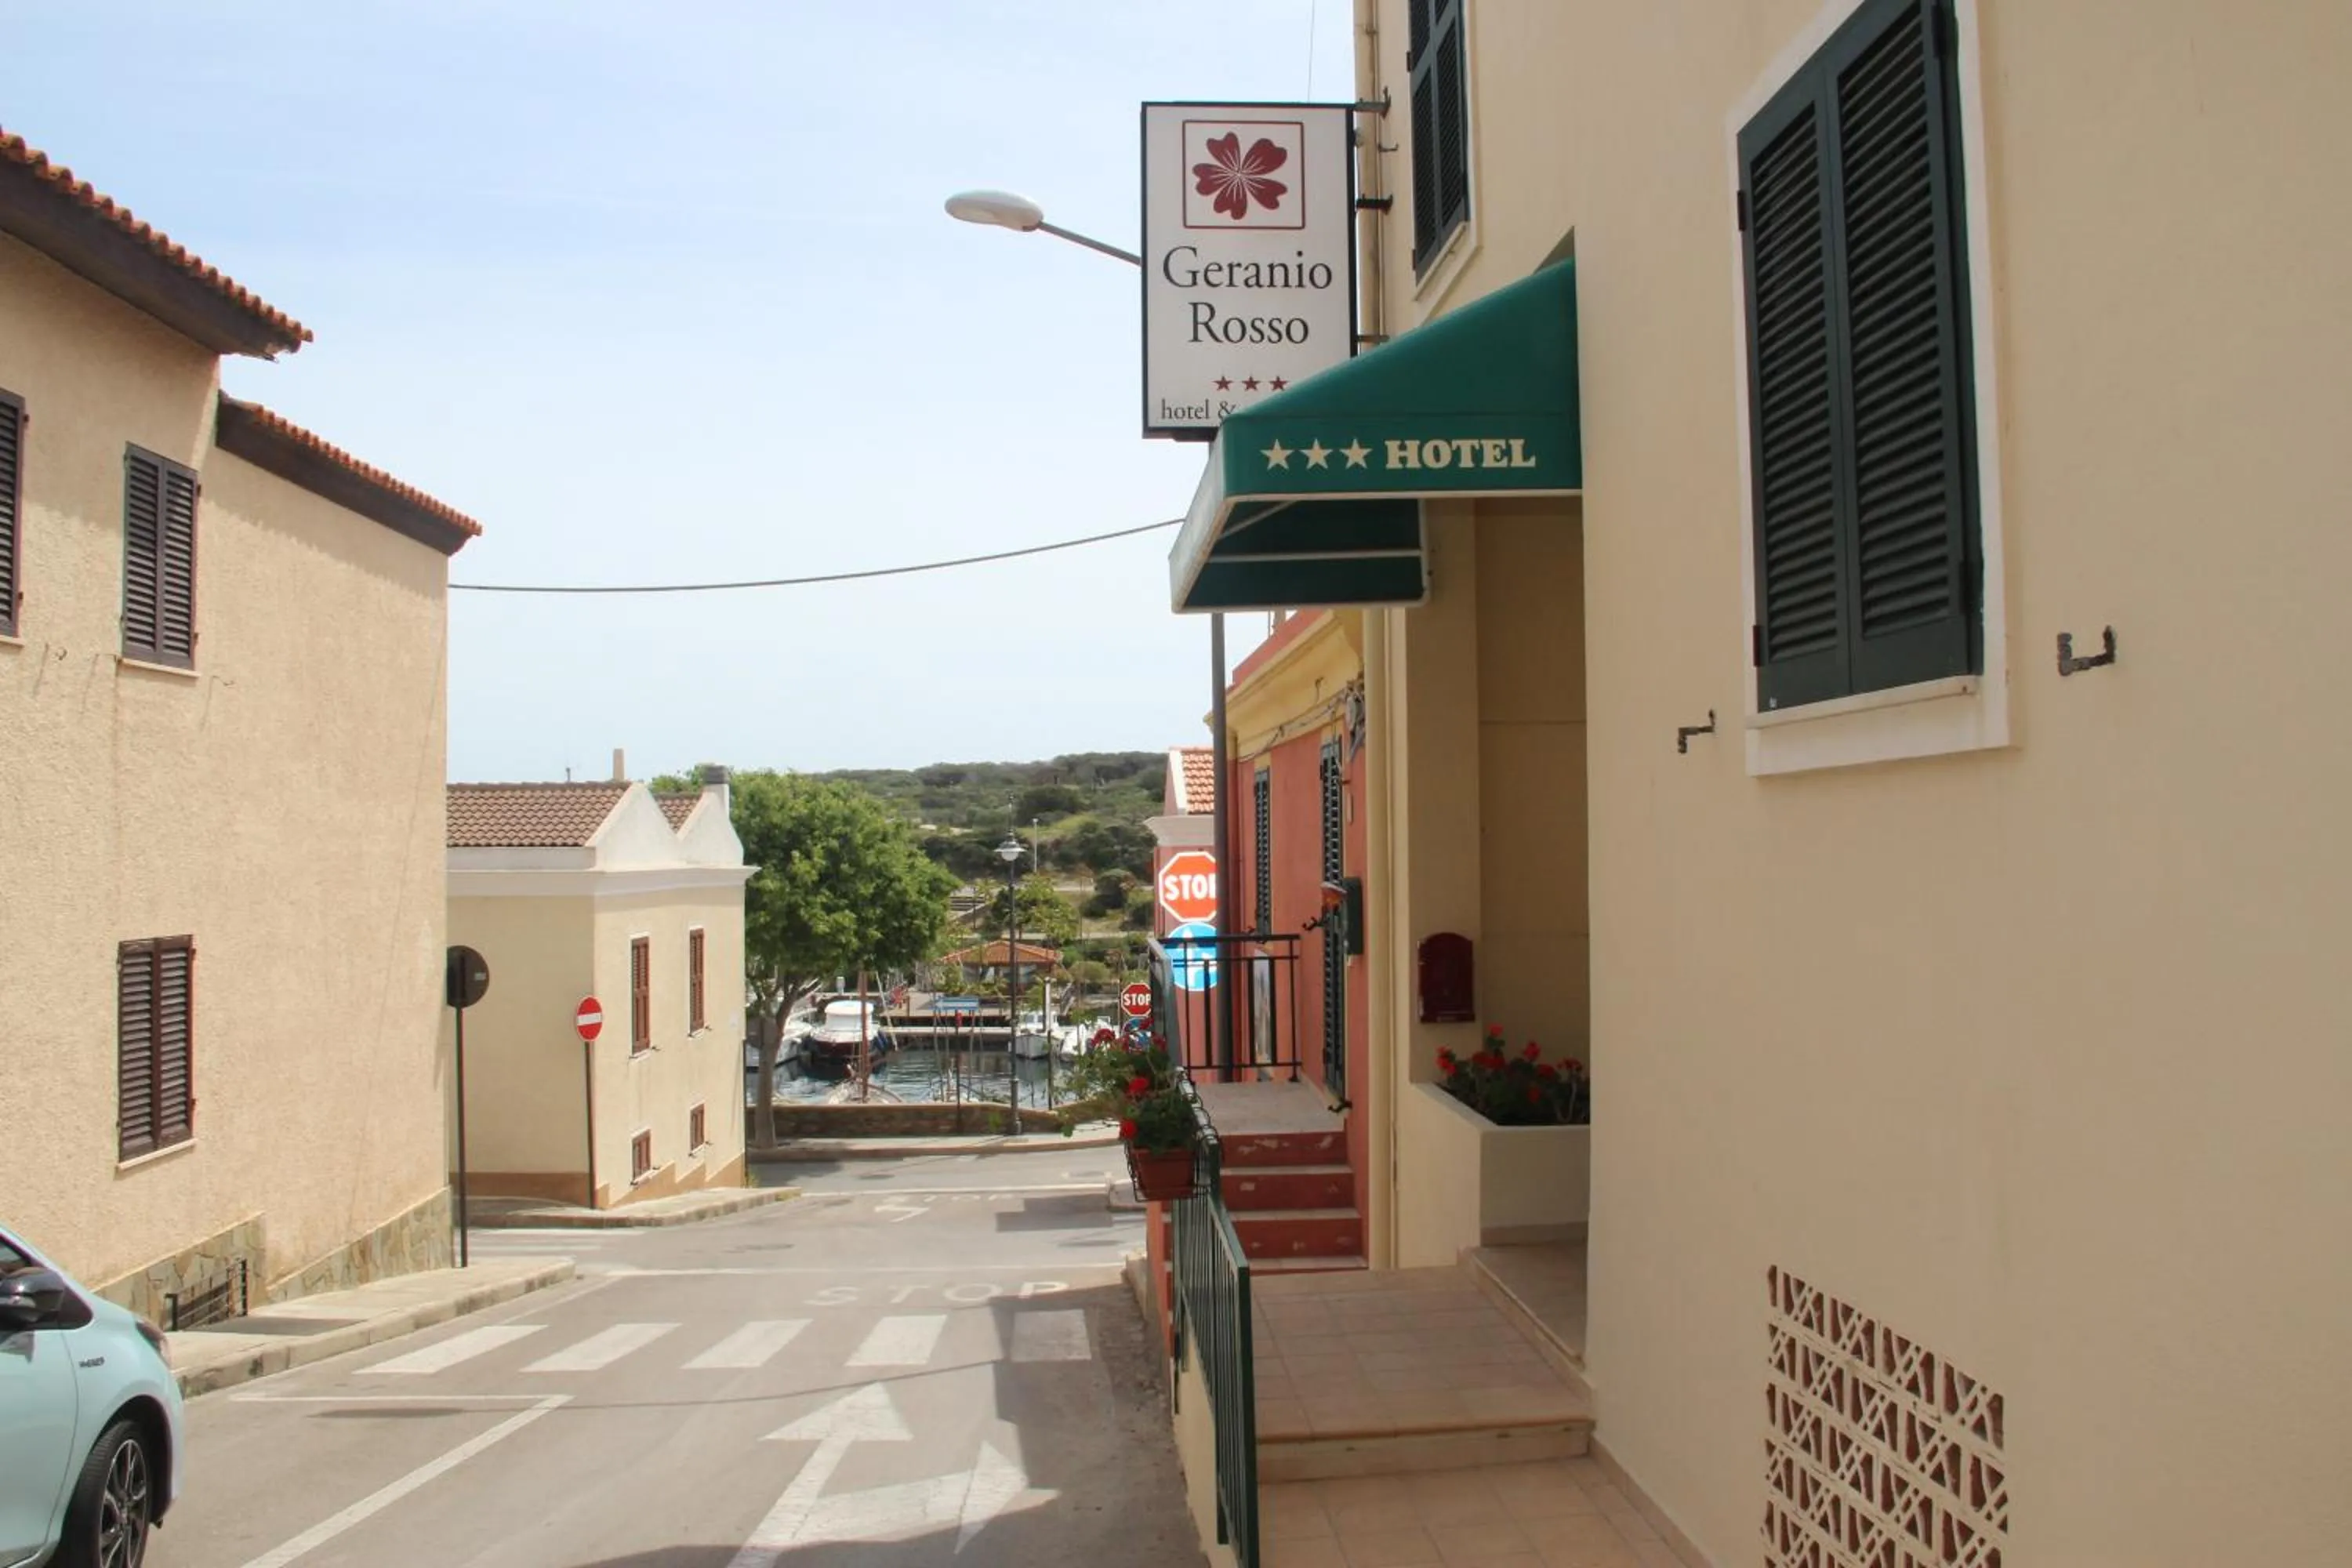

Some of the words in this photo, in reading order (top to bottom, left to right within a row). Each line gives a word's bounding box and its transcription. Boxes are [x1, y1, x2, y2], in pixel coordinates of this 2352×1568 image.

[1162, 245, 1333, 290] Geranio
[1188, 301, 1309, 344] Rosso
[1160, 398, 1210, 419] hotel
[1384, 438, 1536, 469] HOTEL
[1123, 993, 1152, 1006] STOP
[803, 1280, 1070, 1306] STOP
